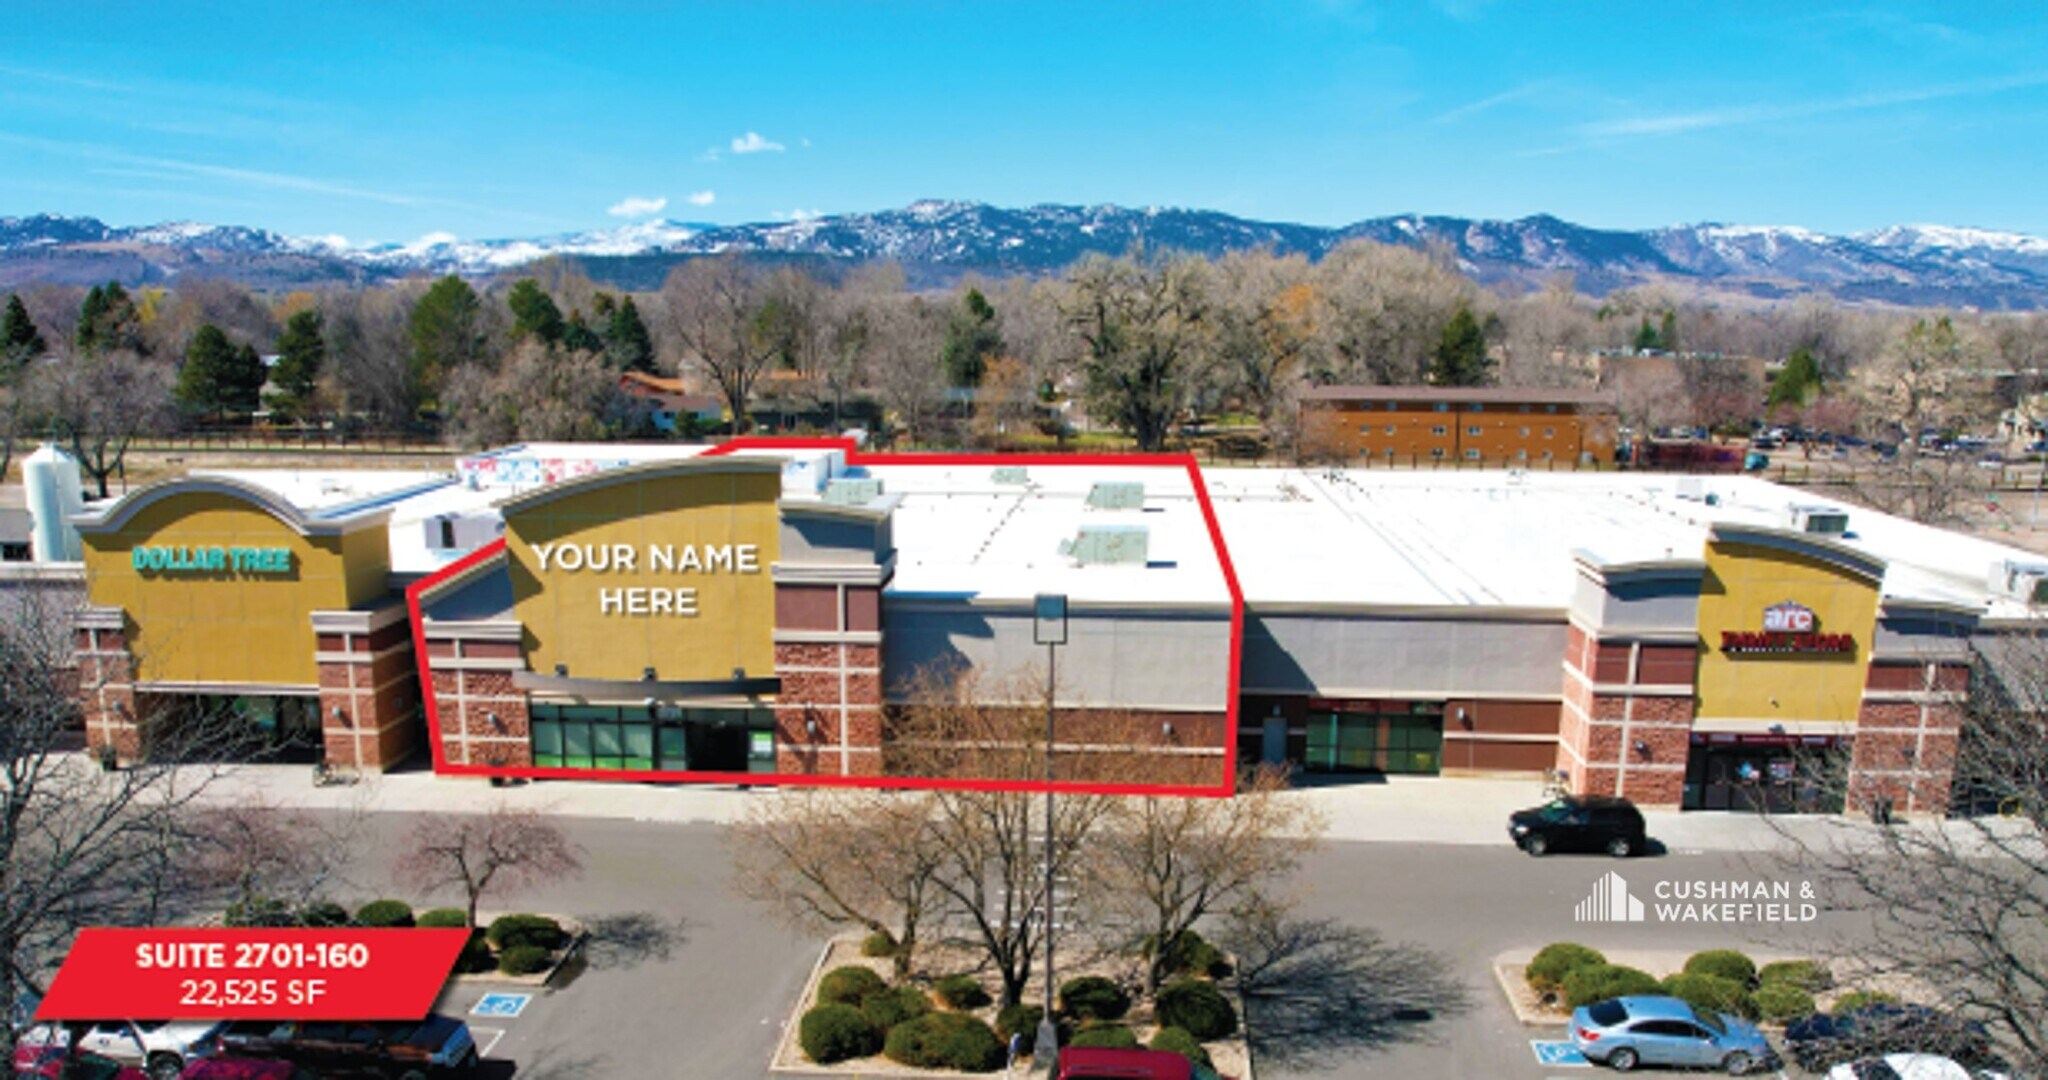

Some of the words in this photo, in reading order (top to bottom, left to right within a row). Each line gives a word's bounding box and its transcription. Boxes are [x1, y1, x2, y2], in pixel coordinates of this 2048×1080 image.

[132, 545, 225, 570] DOLLAR
[229, 547, 290, 571] TREE
[1764, 609, 1812, 630] arc
